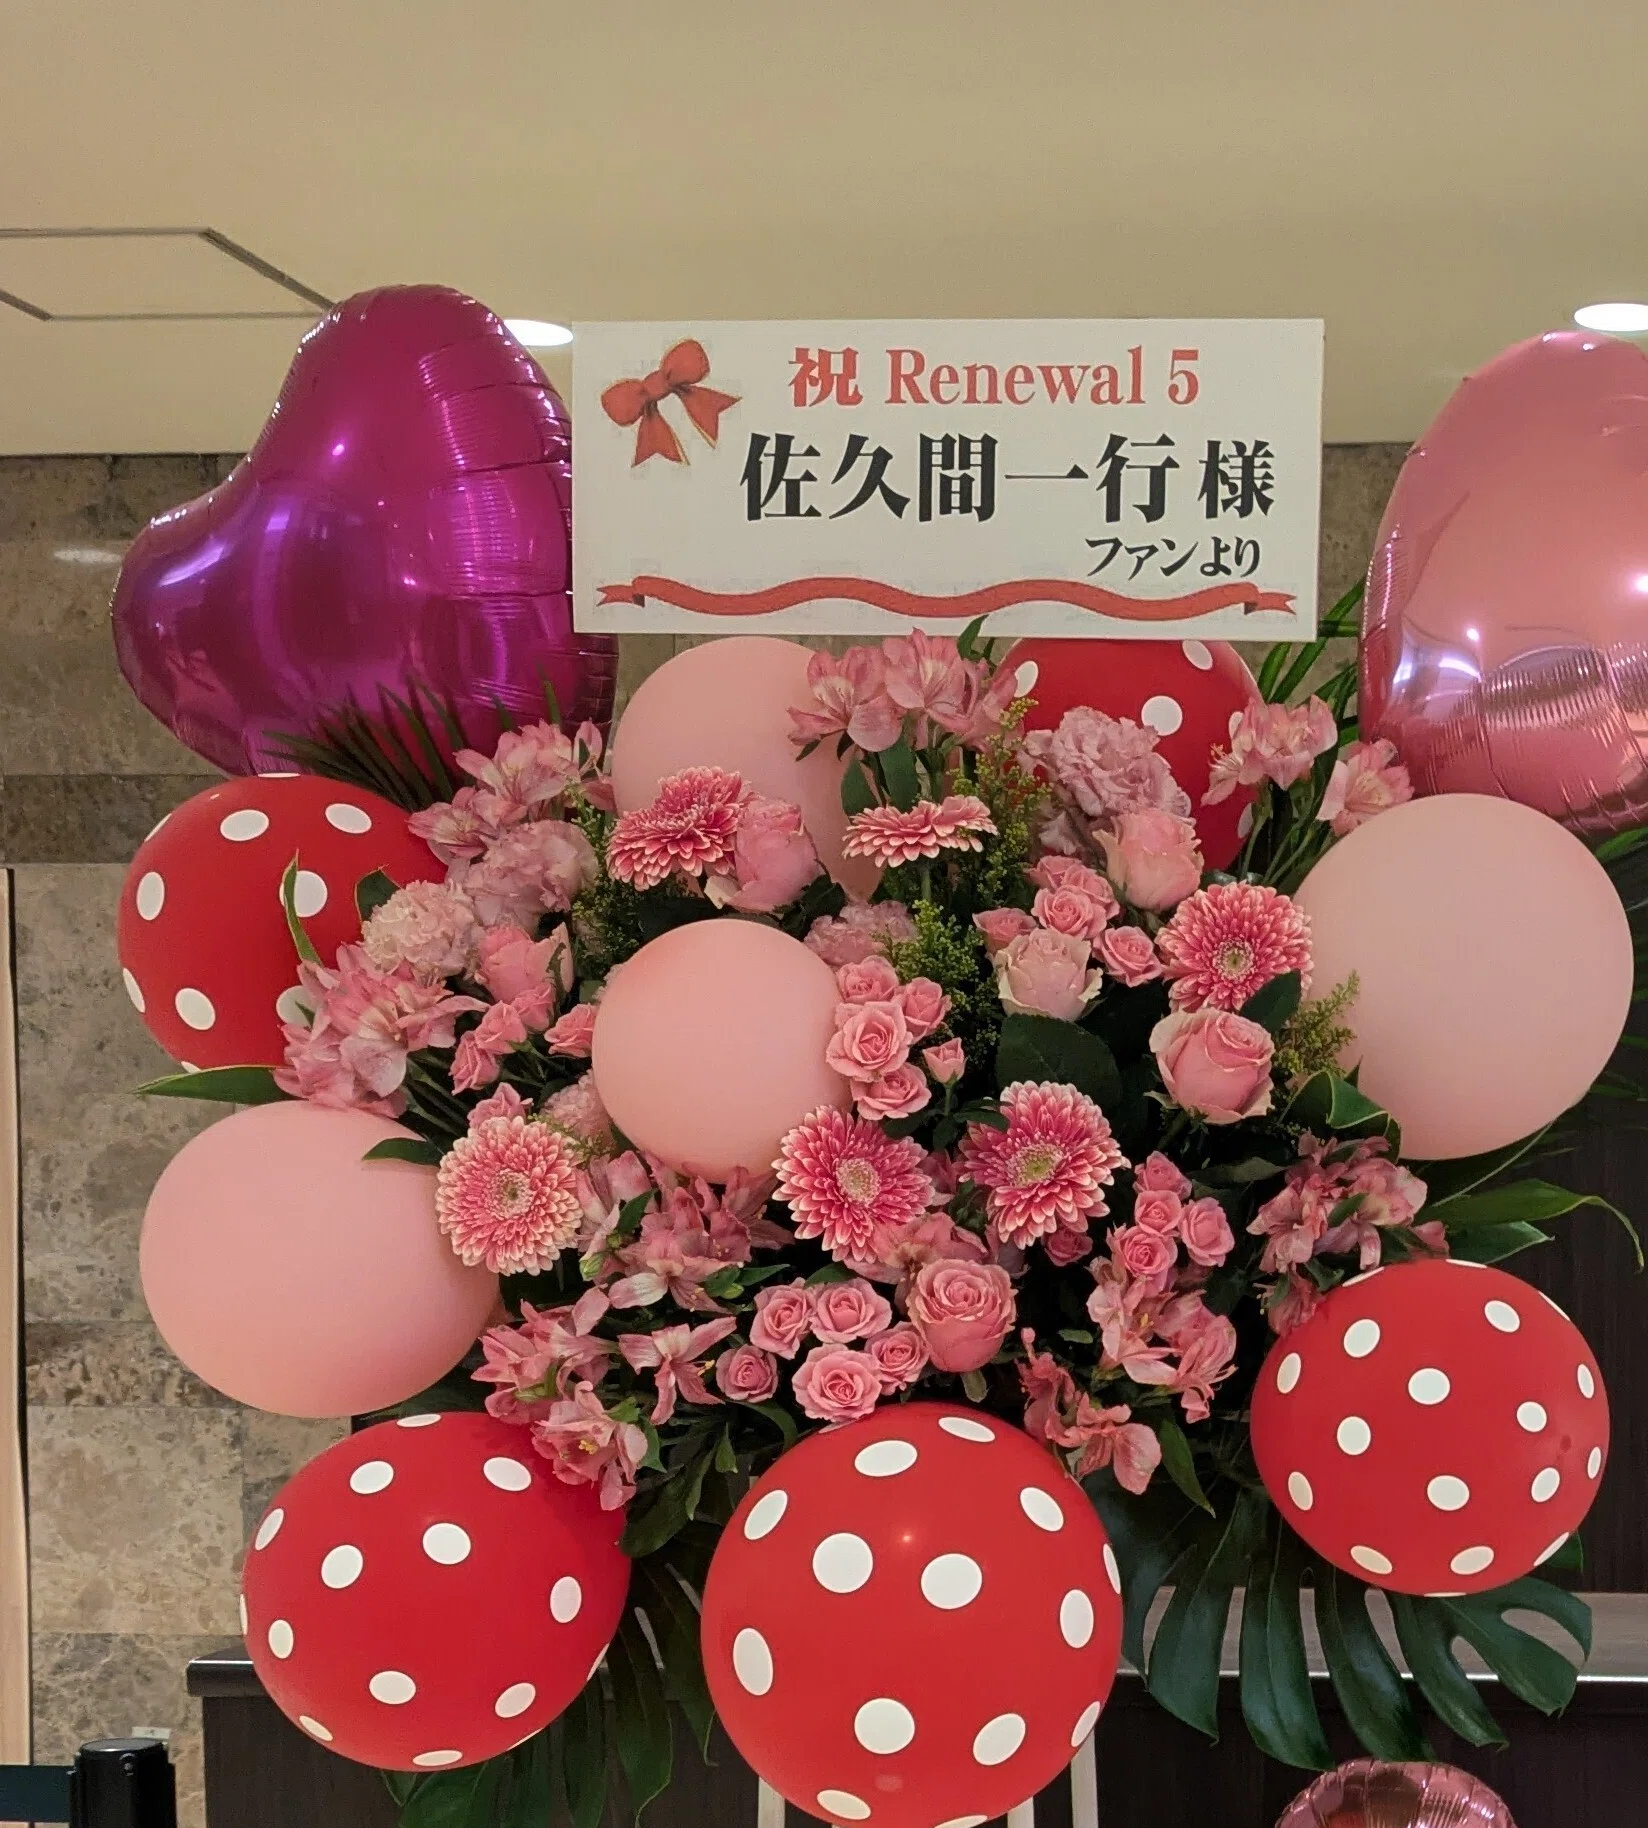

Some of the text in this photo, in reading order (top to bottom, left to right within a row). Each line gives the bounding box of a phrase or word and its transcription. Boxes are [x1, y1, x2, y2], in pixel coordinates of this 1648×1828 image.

[788, 345, 1200, 407] 祝 Renewal 5
[740, 431, 1276, 523] 佐久間一行 様
[1084, 534, 1262, 581] ファンより
